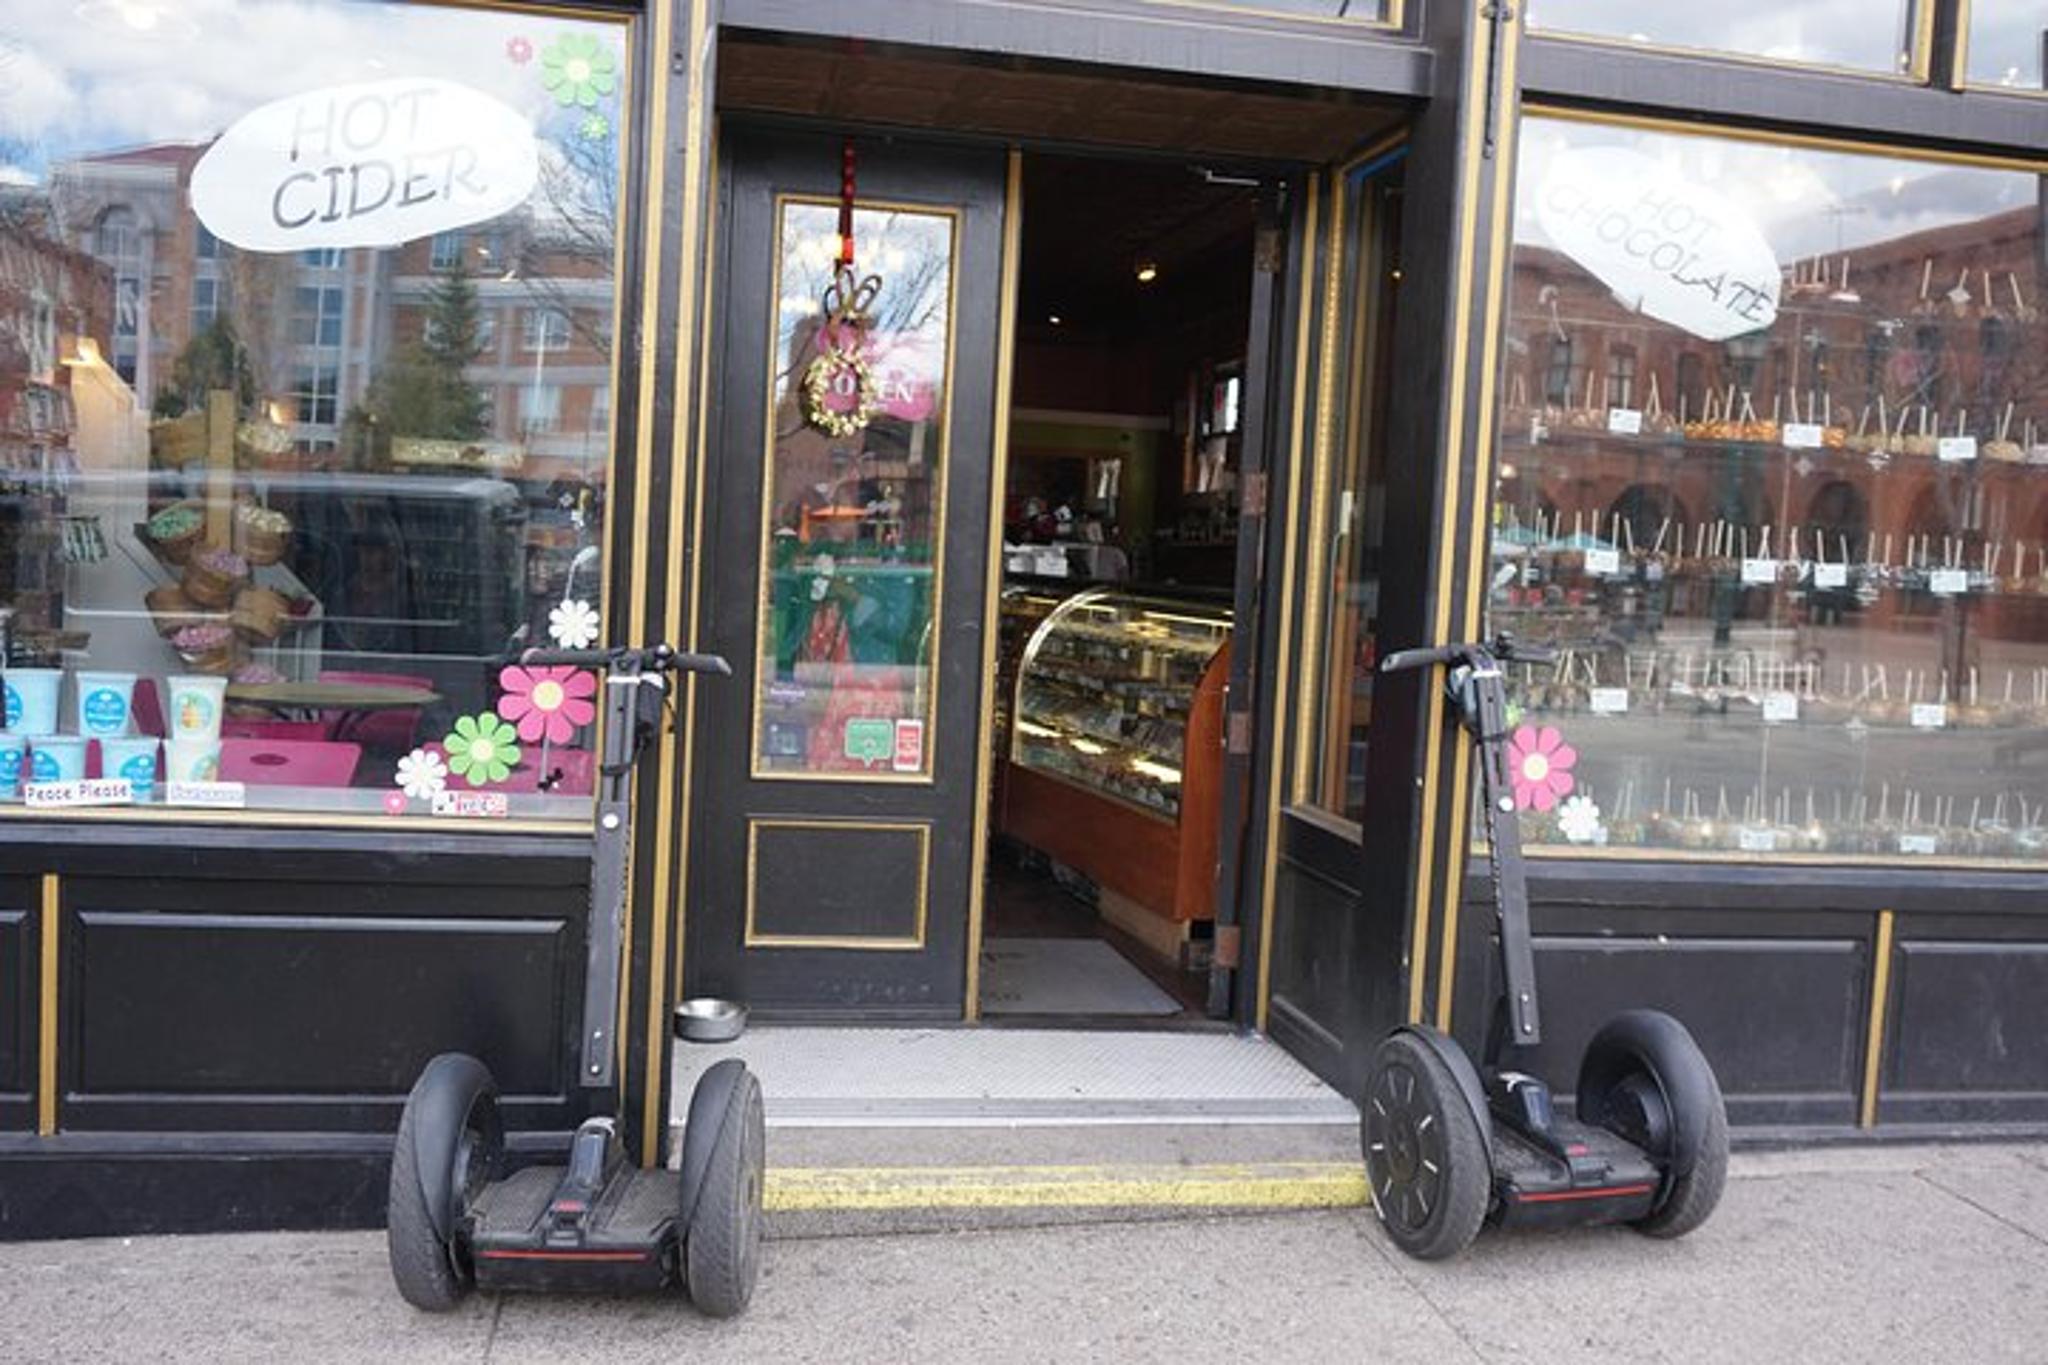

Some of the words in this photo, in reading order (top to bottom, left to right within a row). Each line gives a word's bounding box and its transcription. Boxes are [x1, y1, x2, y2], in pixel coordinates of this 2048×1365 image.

[291, 88, 440, 161] HOT
[272, 145, 488, 229] CIDER
[1631, 187, 1723, 245] HOT
[1547, 184, 1773, 323] CHOCOLATE
[834, 371, 914, 403] OEN
